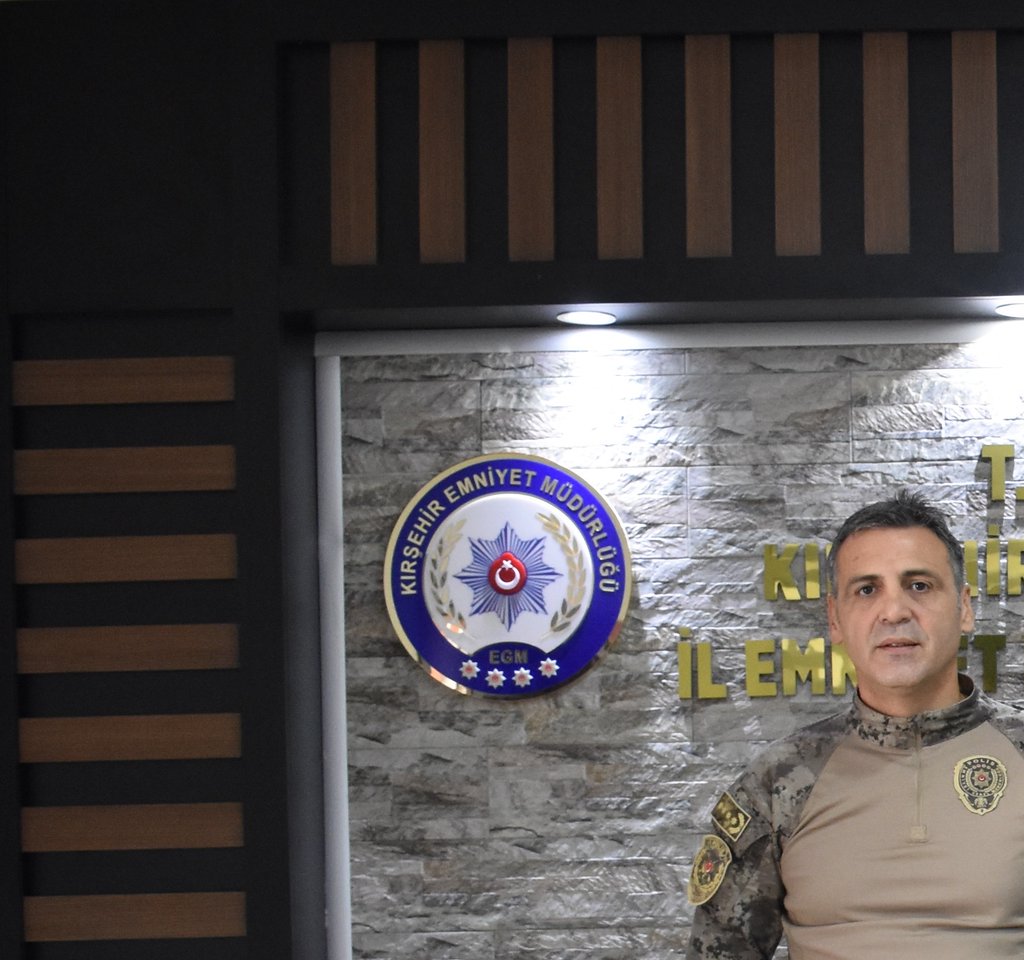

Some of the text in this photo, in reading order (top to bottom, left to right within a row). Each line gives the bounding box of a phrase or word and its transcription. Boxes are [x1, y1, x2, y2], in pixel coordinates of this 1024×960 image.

[400, 466, 620, 595] KIRŞEHİR EMNİYET MÜDÜRLÜĞÜ
[489, 650, 529, 665] EGM
[678, 627, 727, 699] İL
